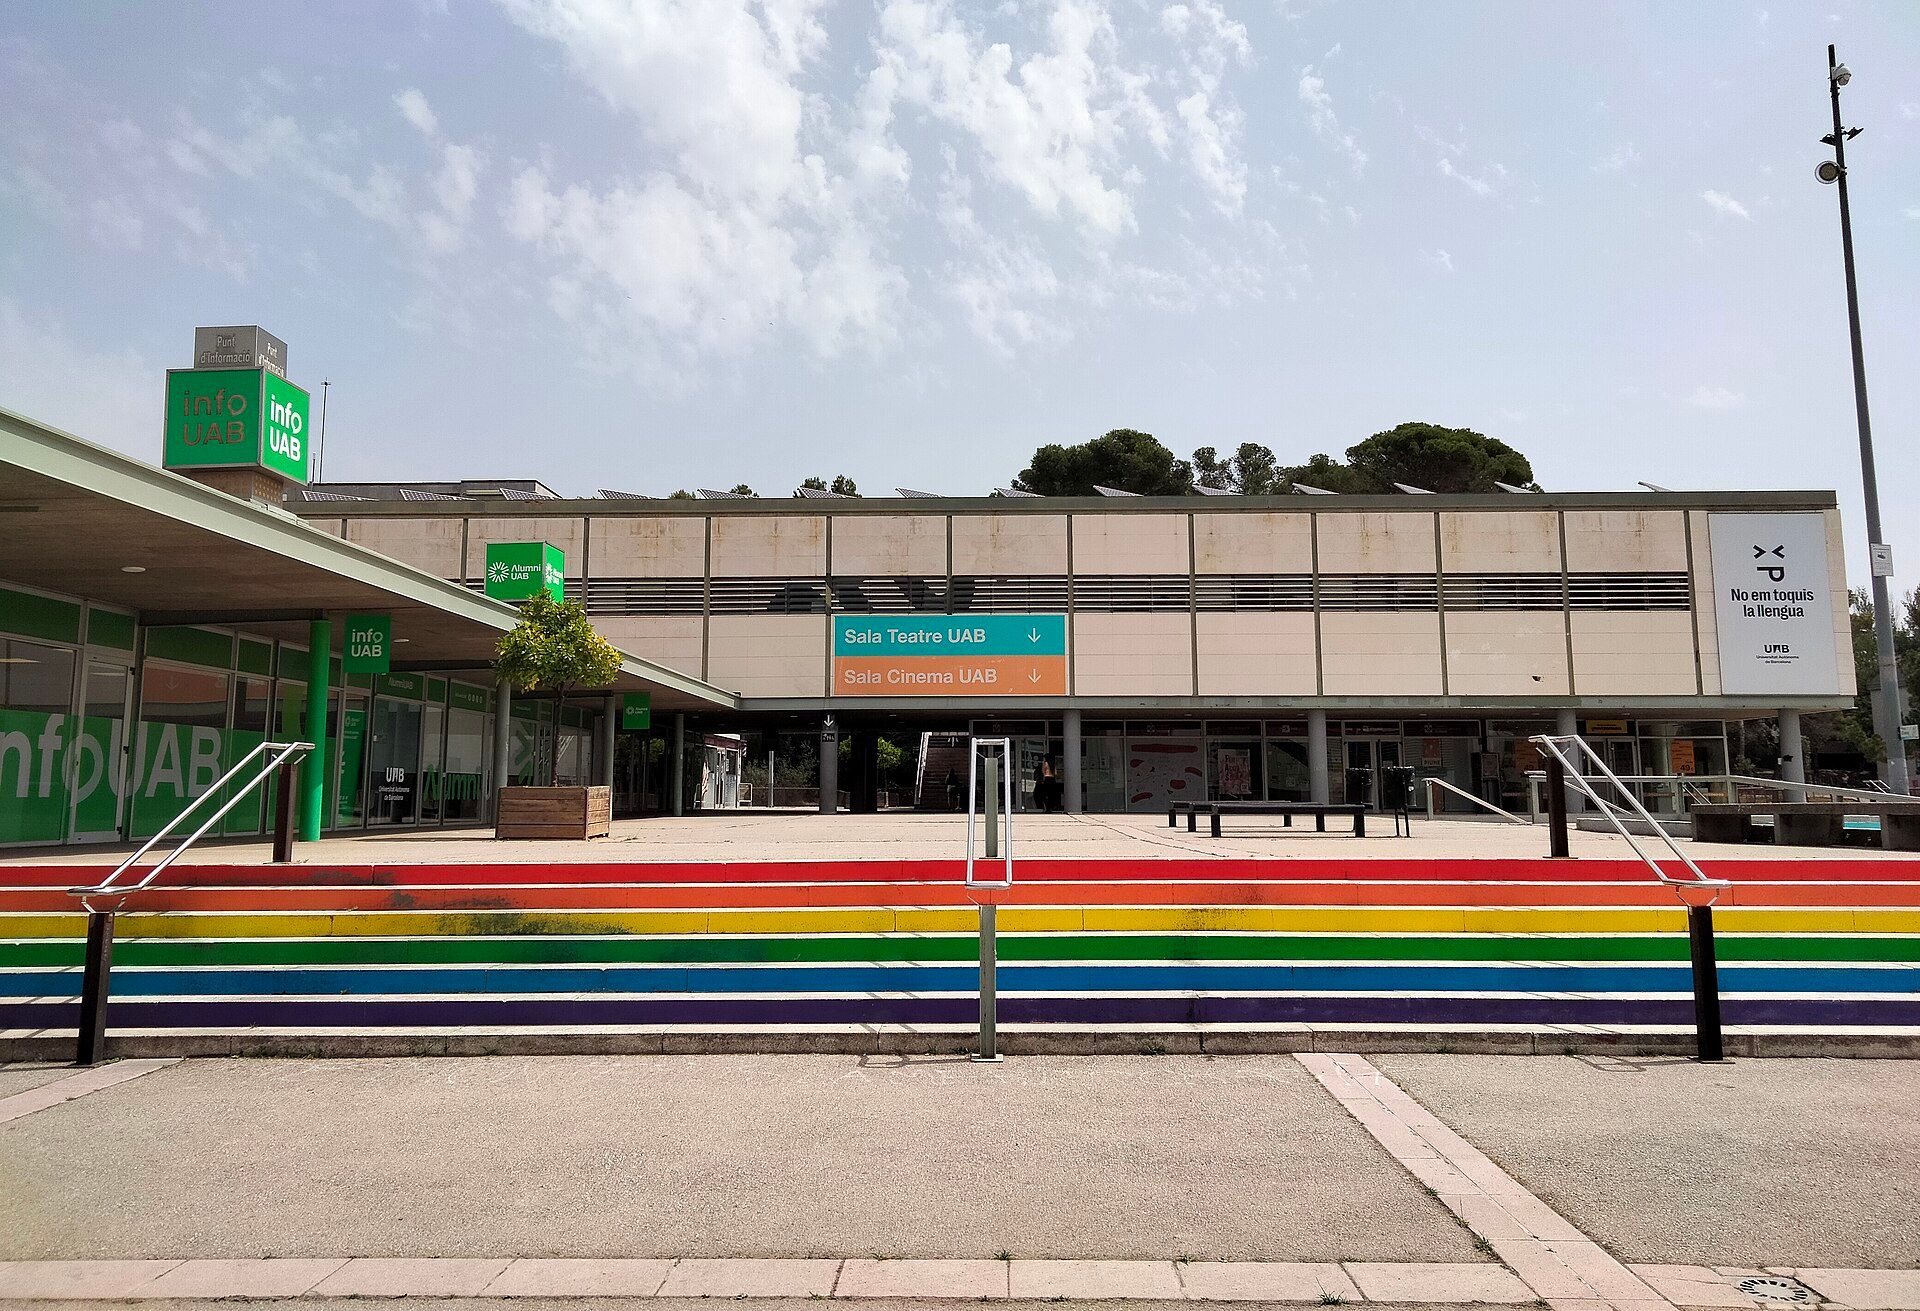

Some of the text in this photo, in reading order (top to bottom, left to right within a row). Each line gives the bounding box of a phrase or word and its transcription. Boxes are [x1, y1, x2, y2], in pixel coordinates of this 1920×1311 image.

[217, 335, 236, 347] Punt
[200, 350, 250, 364] d'Informació
[183, 388, 247, 416] info
[270, 394, 303, 435] info
[183, 421, 245, 446] UAB
[270, 426, 301, 462] UAB
[511, 563, 541, 572] Alumni
[511, 572, 529, 580] UAB
[1731, 588, 1814, 604] No em toquis
[1743, 605, 1804, 620] la llengua
[352, 628, 383, 643] info
[844, 628, 986, 644] Sala Teatre UAB
[351, 645, 382, 657] UAB
[1764, 644, 1790, 654] UAB
[844, 668, 997, 684] Sala Cinema UAB
[386, 767, 405, 783] UAB
